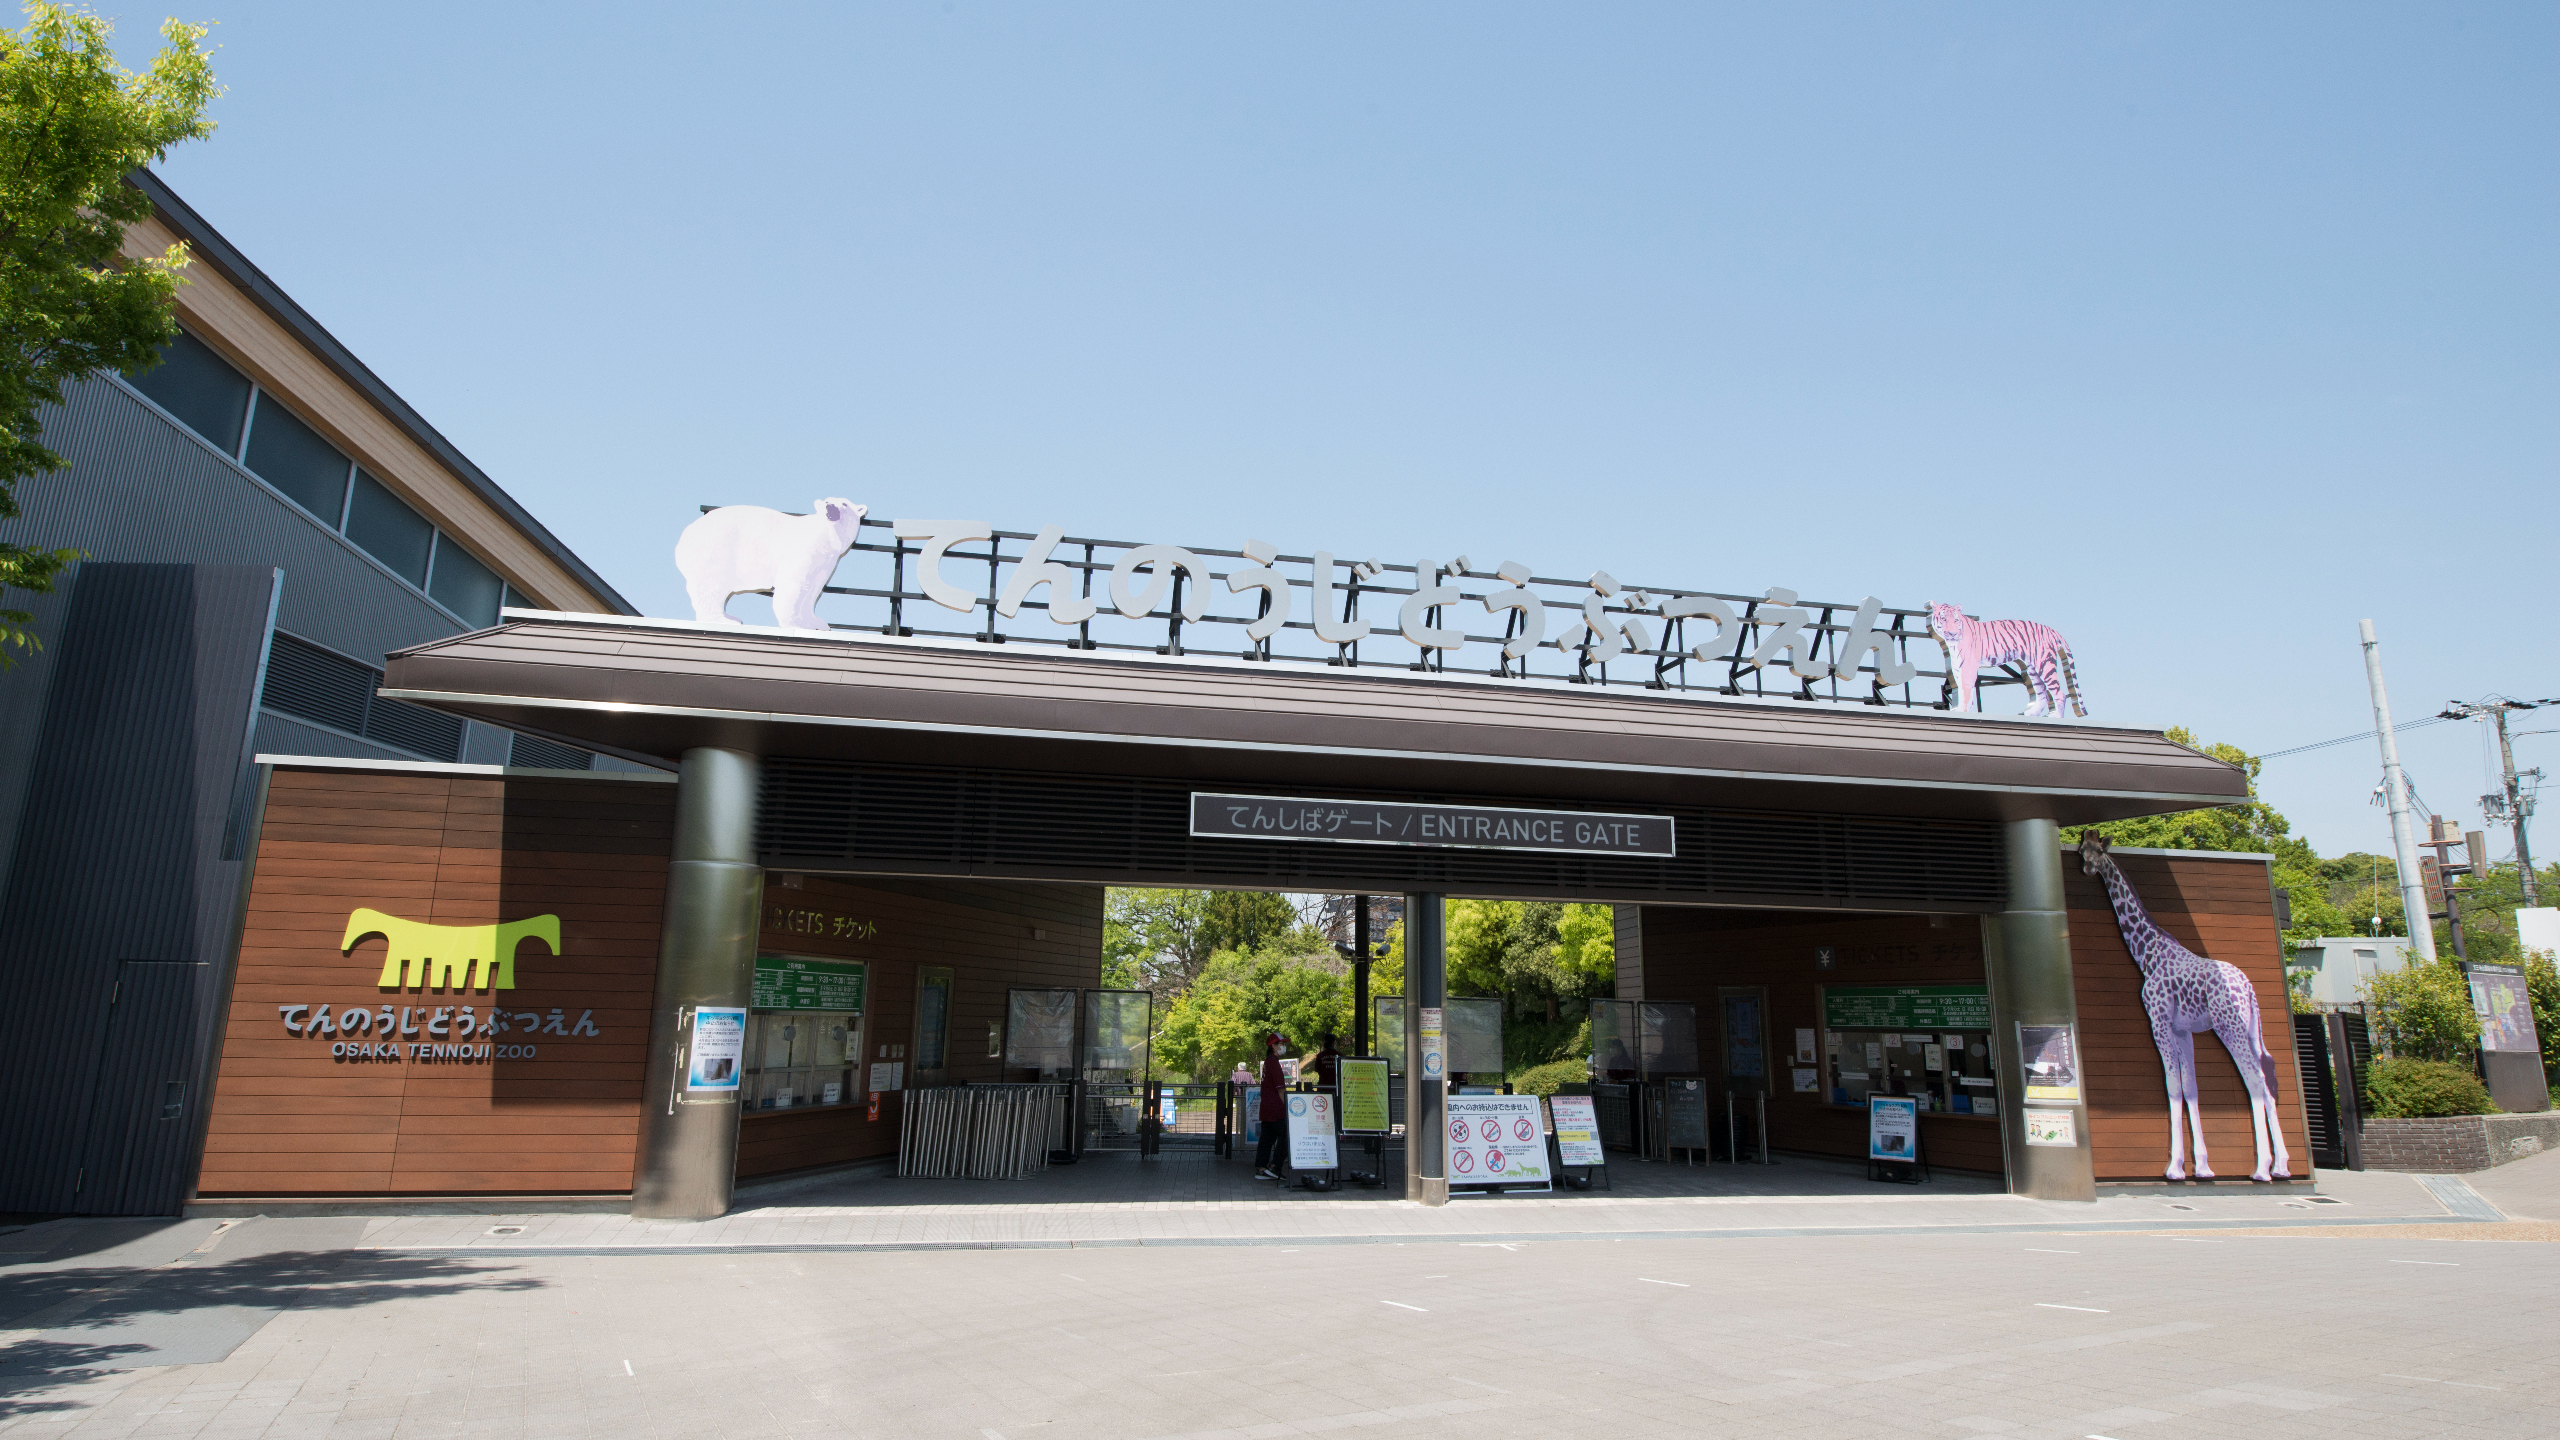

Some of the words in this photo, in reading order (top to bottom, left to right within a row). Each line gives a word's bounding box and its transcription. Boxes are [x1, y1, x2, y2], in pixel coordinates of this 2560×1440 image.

[893, 518, 1916, 687] てんのうじどうぶつえん
[1226, 806, 1392, 835] てんしばゲート
[1421, 814, 1565, 843] ENTRANCE
[1575, 821, 1641, 847] GATE
[762, 905, 824, 934] ICKETS
[833, 916, 877, 941] チケット
[1840, 944, 1920, 965] TICKETS
[279, 1003, 600, 1037] てんのうじどうぶつえん
[332, 1042, 401, 1058] OSAKA
[408, 1043, 491, 1058] TENNOJI
[495, 1044, 537, 1059] ZOO
